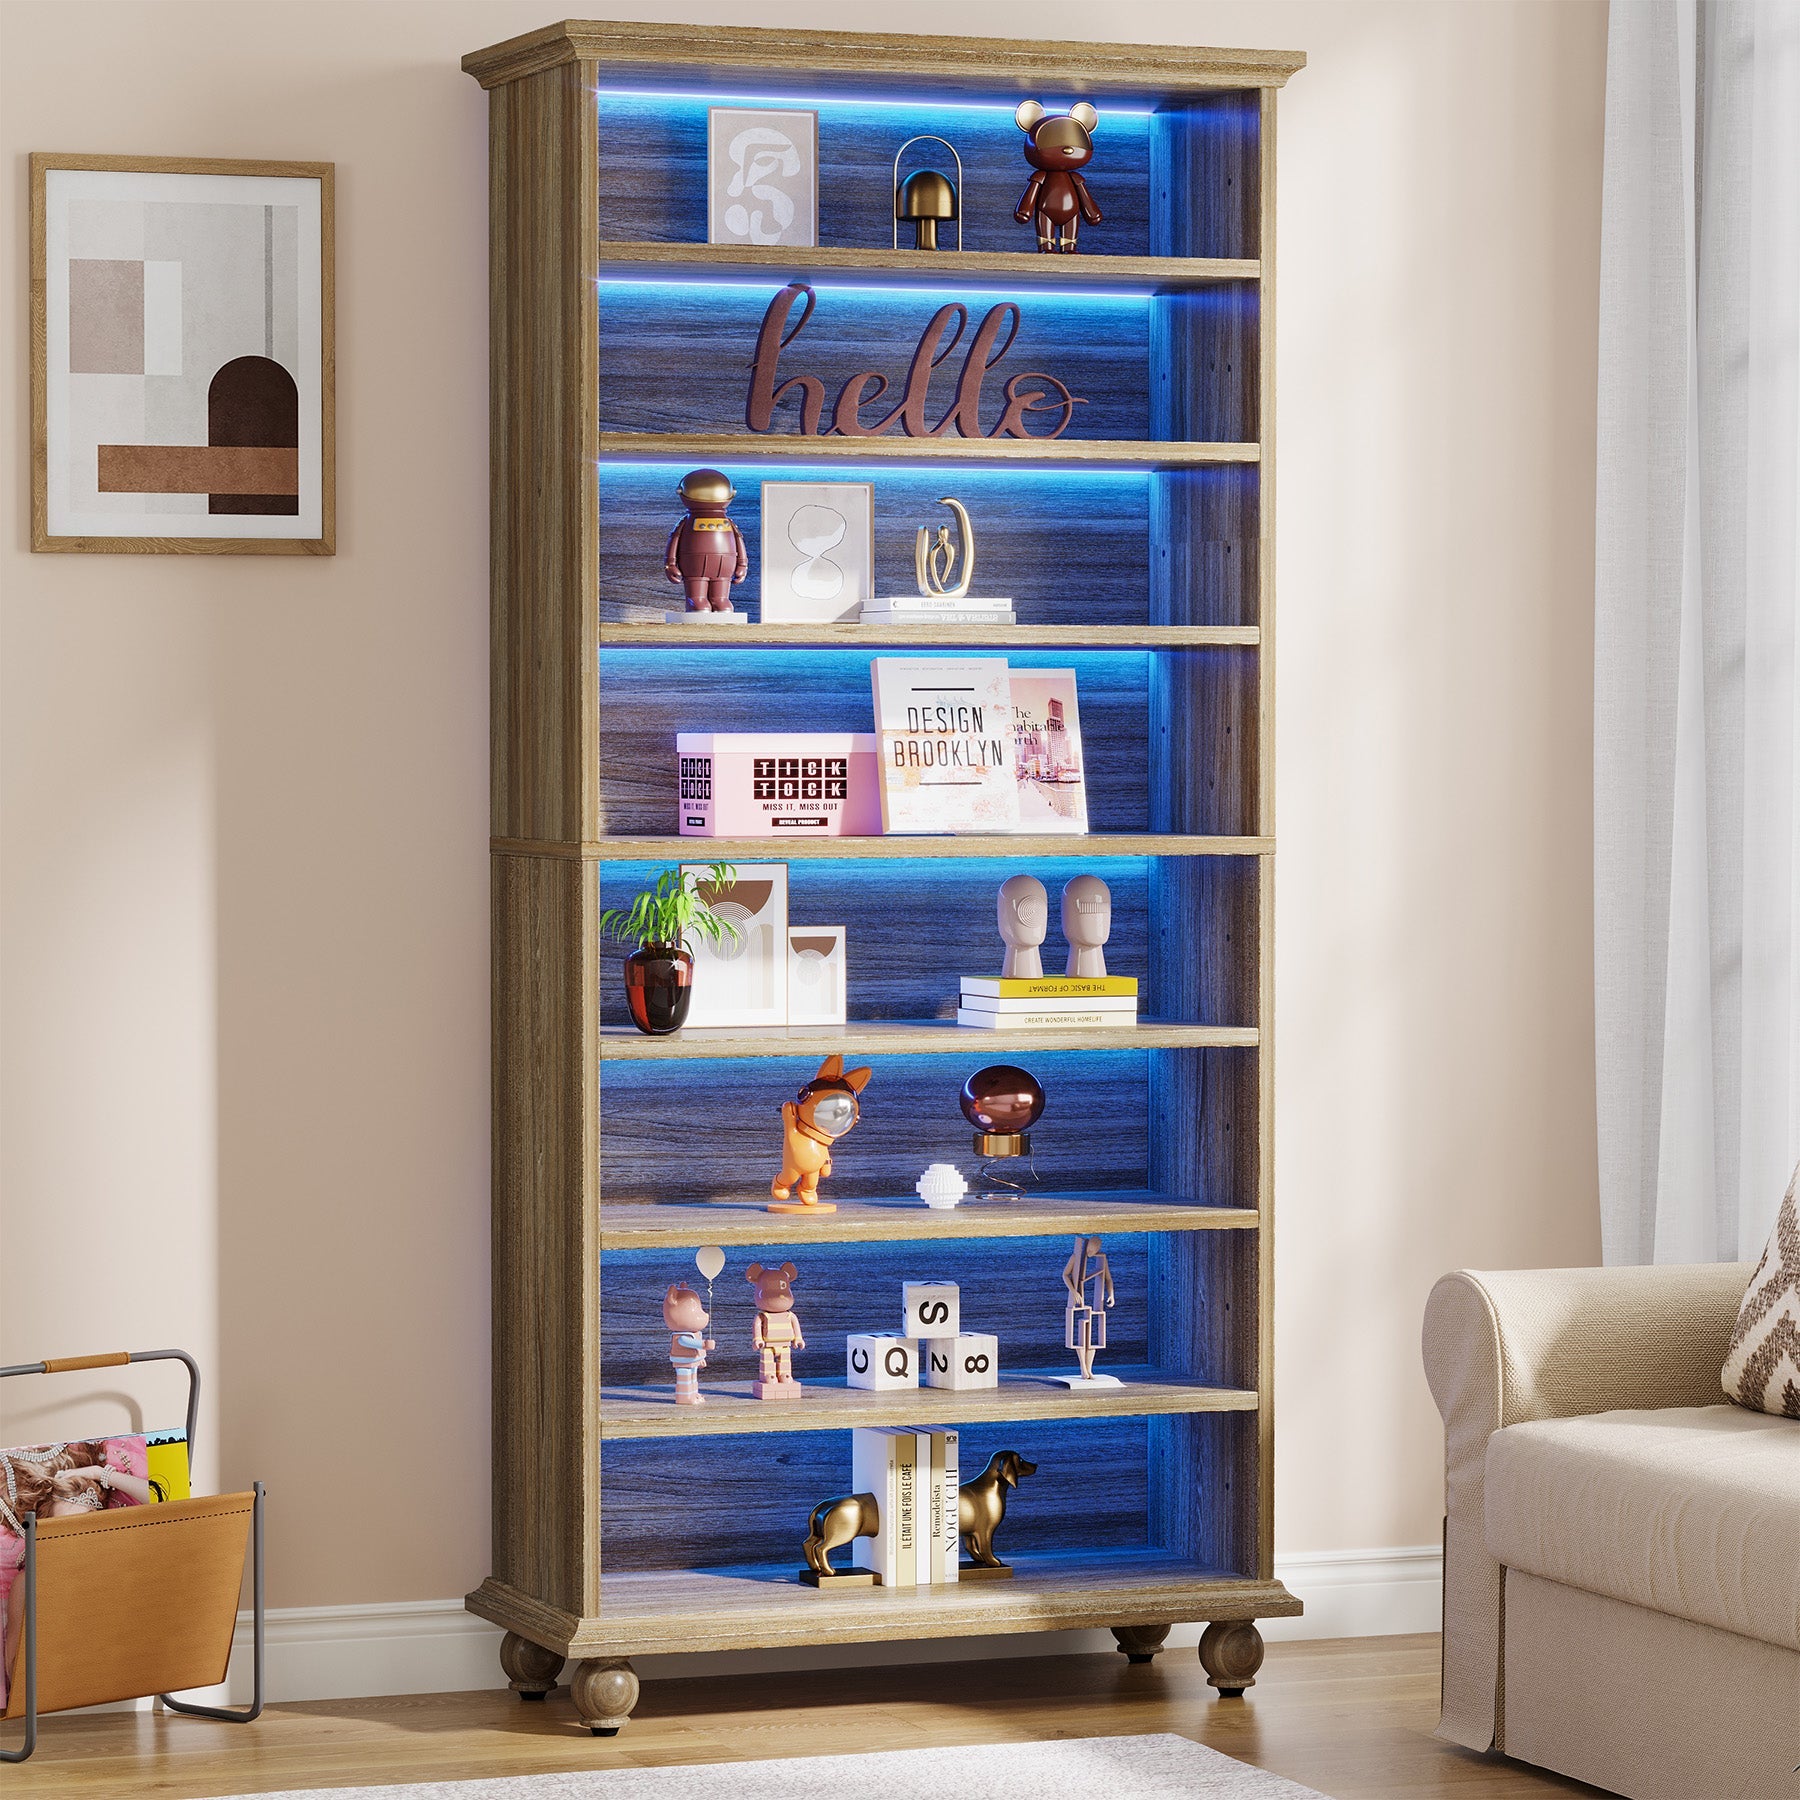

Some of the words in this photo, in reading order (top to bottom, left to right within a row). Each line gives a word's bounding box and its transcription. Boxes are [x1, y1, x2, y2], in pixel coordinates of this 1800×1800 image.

[745, 284, 1089, 439] hello
[1011, 706, 1031, 718] he
[907, 706, 984, 734] DESIGN
[894, 739, 1003, 767] BROOKLYN
[760, 761, 841, 776] TICK
[760, 782, 841, 797] TOCK
[762, 803, 783, 811] MISS
[799, 803, 820, 811] MISS
[822, 803, 838, 811] OUT
[1028, 985, 1058, 993] FORMAT
[1071, 984, 1091, 992] BASIC
[918, 1300, 949, 1325] S
[884, 1346, 909, 1379] Q
[964, 1353, 990, 1374] 8
[902, 1482, 912, 1491] LE
[902, 1492, 912, 1507] FOIS
[902, 1508, 912, 1521] UNE
[932, 1484, 941, 1538] Remodelista
[945, 1469, 958, 1552] NOGUCHI
